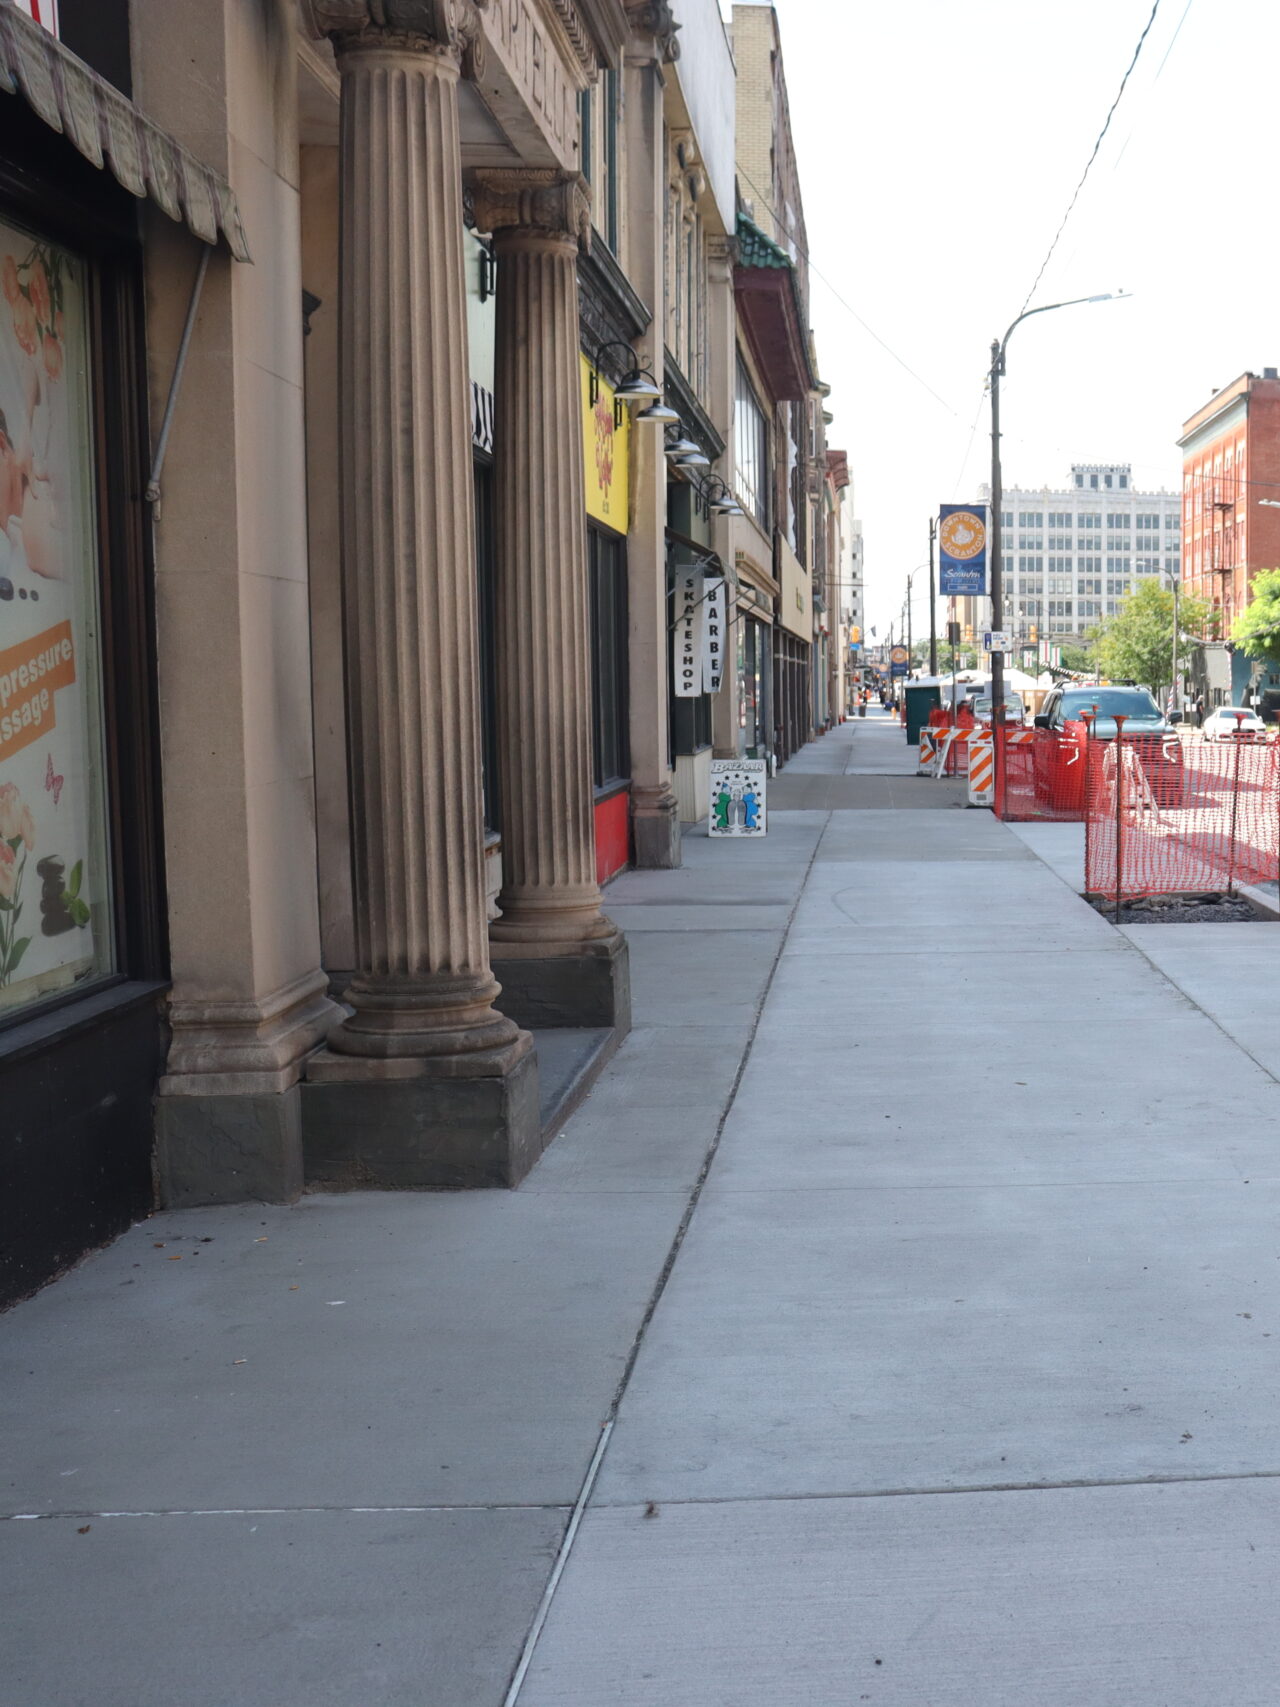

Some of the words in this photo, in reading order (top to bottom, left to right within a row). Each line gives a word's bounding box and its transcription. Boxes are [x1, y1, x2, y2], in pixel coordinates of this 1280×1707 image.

[942, 514, 982, 537] DOWNTOWN
[683, 578, 695, 691] SKATESHOP
[708, 590, 720, 688] BARBER
[0, 687, 50, 745] ssage
[711, 761, 764, 774] BAZAAR
